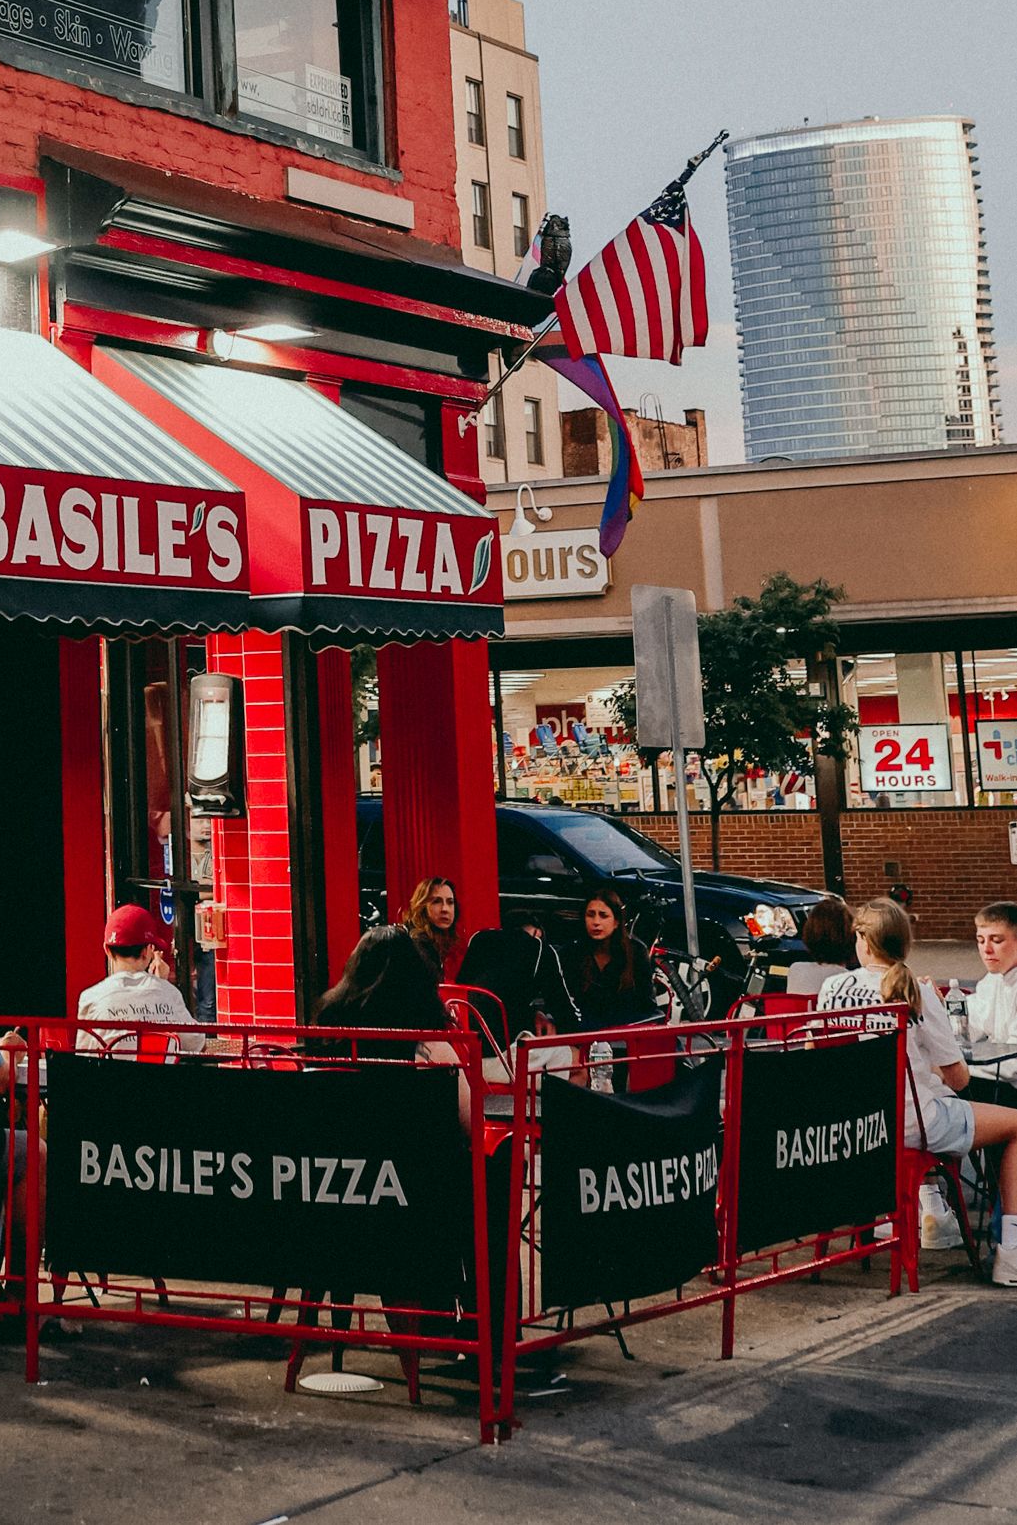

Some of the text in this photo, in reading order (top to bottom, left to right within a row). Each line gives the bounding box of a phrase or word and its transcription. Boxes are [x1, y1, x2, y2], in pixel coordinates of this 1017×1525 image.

[54, 7, 91, 48] Skin
[308, 507, 465, 595] PIZZA
[872, 729, 899, 738] OPEN
[874, 738, 934, 772] 24
[875, 775, 936, 787] HOURS
[107, 1008, 128, 1017] New
[776, 1109, 889, 1169] BASILE'S PIZZA
[80, 1140, 408, 1207] BASILE'S PIZZA
[579, 1143, 718, 1214] BASILE'S PIZZA
